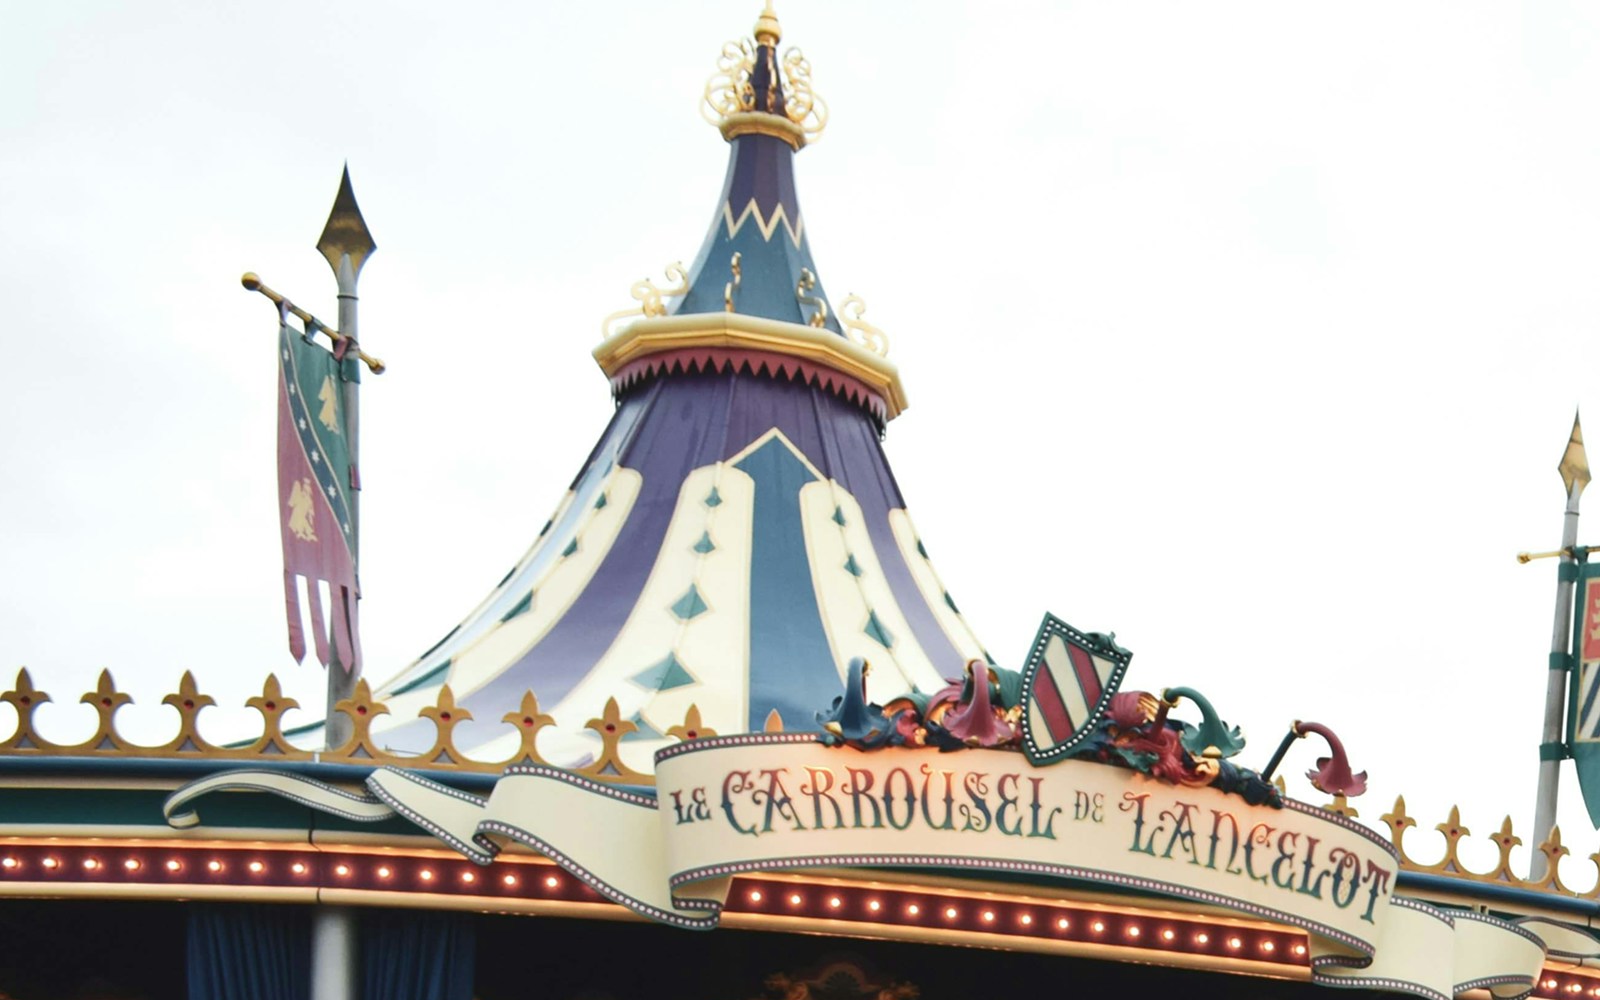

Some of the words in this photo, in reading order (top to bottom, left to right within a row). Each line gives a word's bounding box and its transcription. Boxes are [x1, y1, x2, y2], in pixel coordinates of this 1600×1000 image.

[670, 786, 713, 825] LE
[721, 763, 1062, 841] CARROUSEL
[1074, 790, 1104, 823] DE
[1119, 791, 1391, 925] LANCELOT
